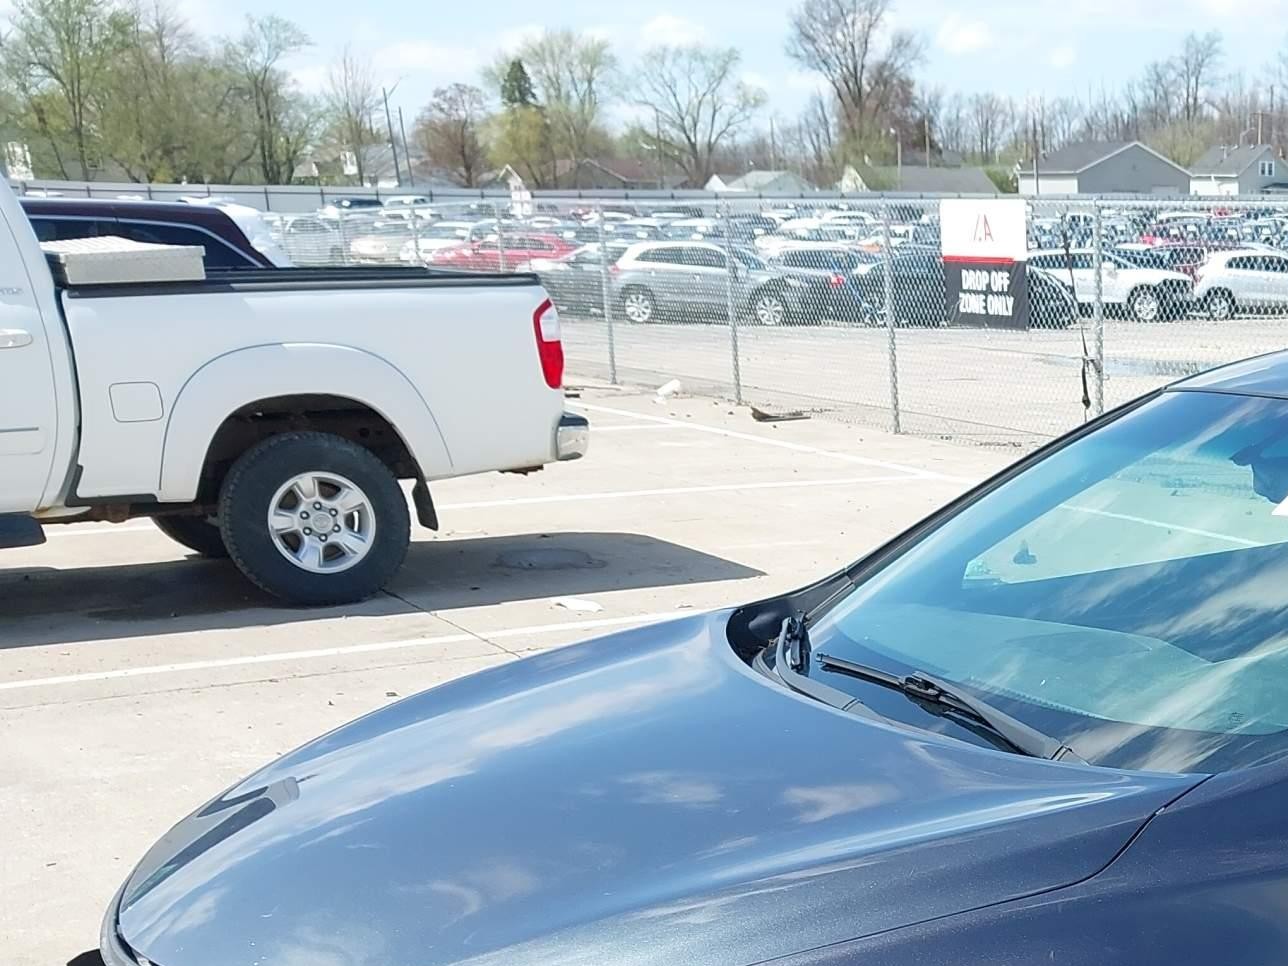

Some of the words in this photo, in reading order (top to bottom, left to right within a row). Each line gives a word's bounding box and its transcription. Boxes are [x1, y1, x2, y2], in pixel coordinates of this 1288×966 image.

[961, 268, 990, 291] DROP
[991, 270, 1010, 292] OFF
[959, 291, 986, 314] ZONE
[987, 294, 1015, 316] ONLY
